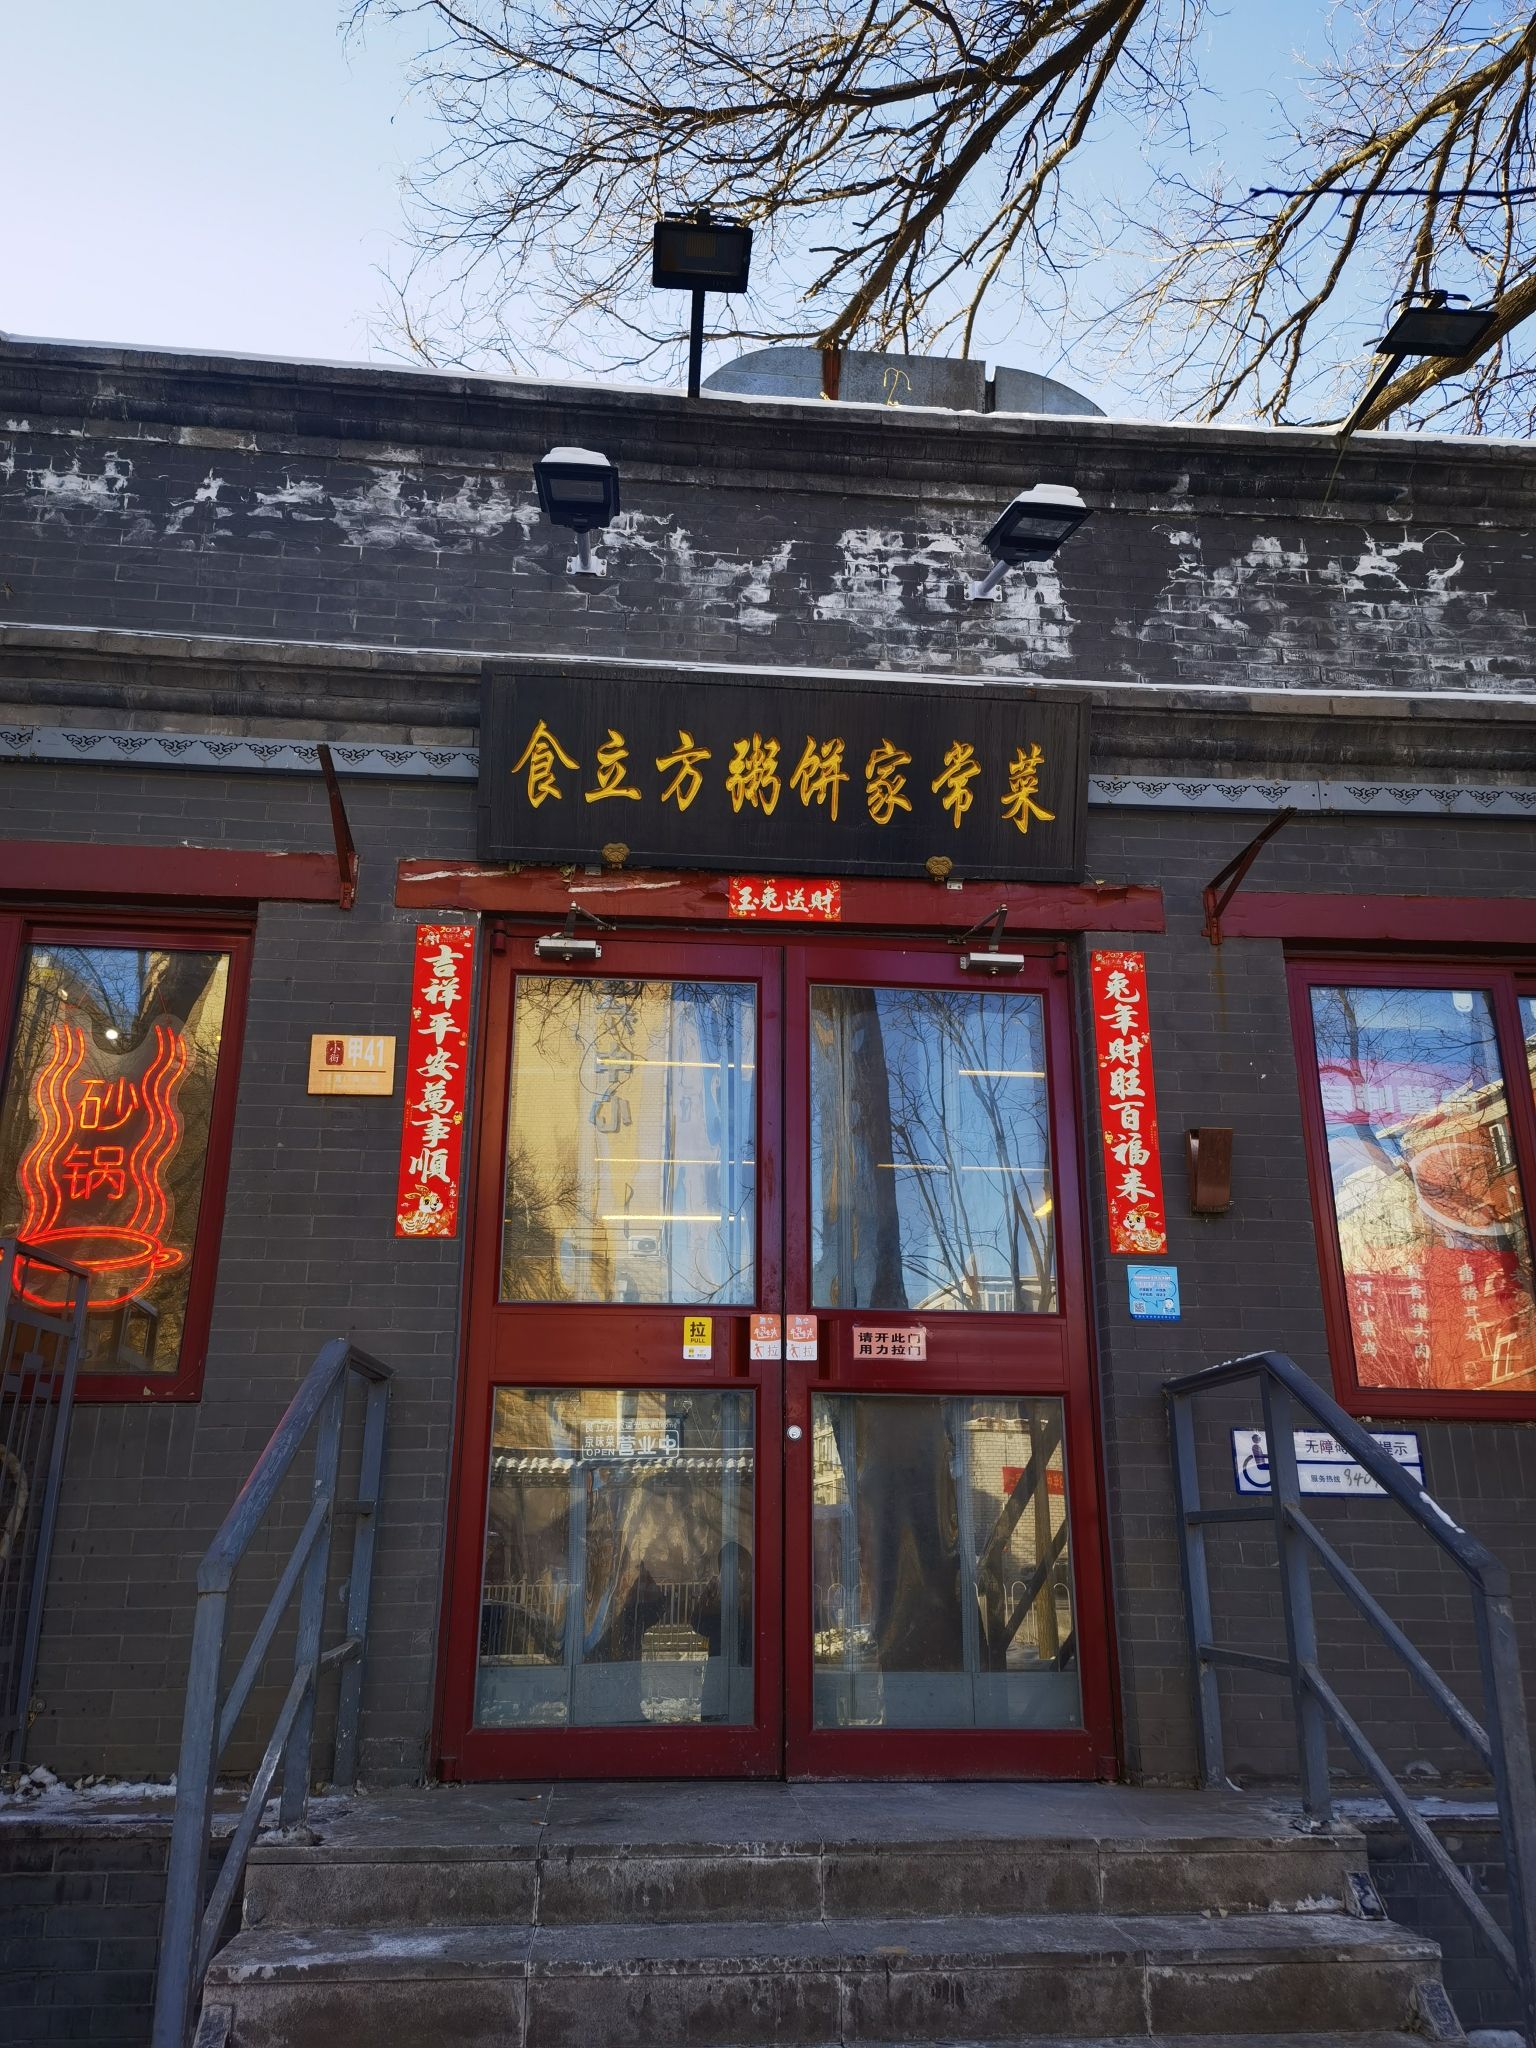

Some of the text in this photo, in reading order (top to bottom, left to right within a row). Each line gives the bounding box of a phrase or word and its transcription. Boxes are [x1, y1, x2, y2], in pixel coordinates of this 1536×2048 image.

[511, 718, 1056, 834] 食立方粥饼家常菜
[62, 1076, 138, 1200] 砂锅
[690, 1321, 706, 1338] 拉
[858, 1332, 921, 1344] 请开此门
[767, 1344, 779, 1357] 拉
[802, 1345, 816, 1358] 拉
[858, 1345, 921, 1356] 用力拉门
[585, 1435, 615, 1447] 京味菜
[619, 1434, 677, 1456] 营业中
[586, 1448, 615, 1456] OPEN
